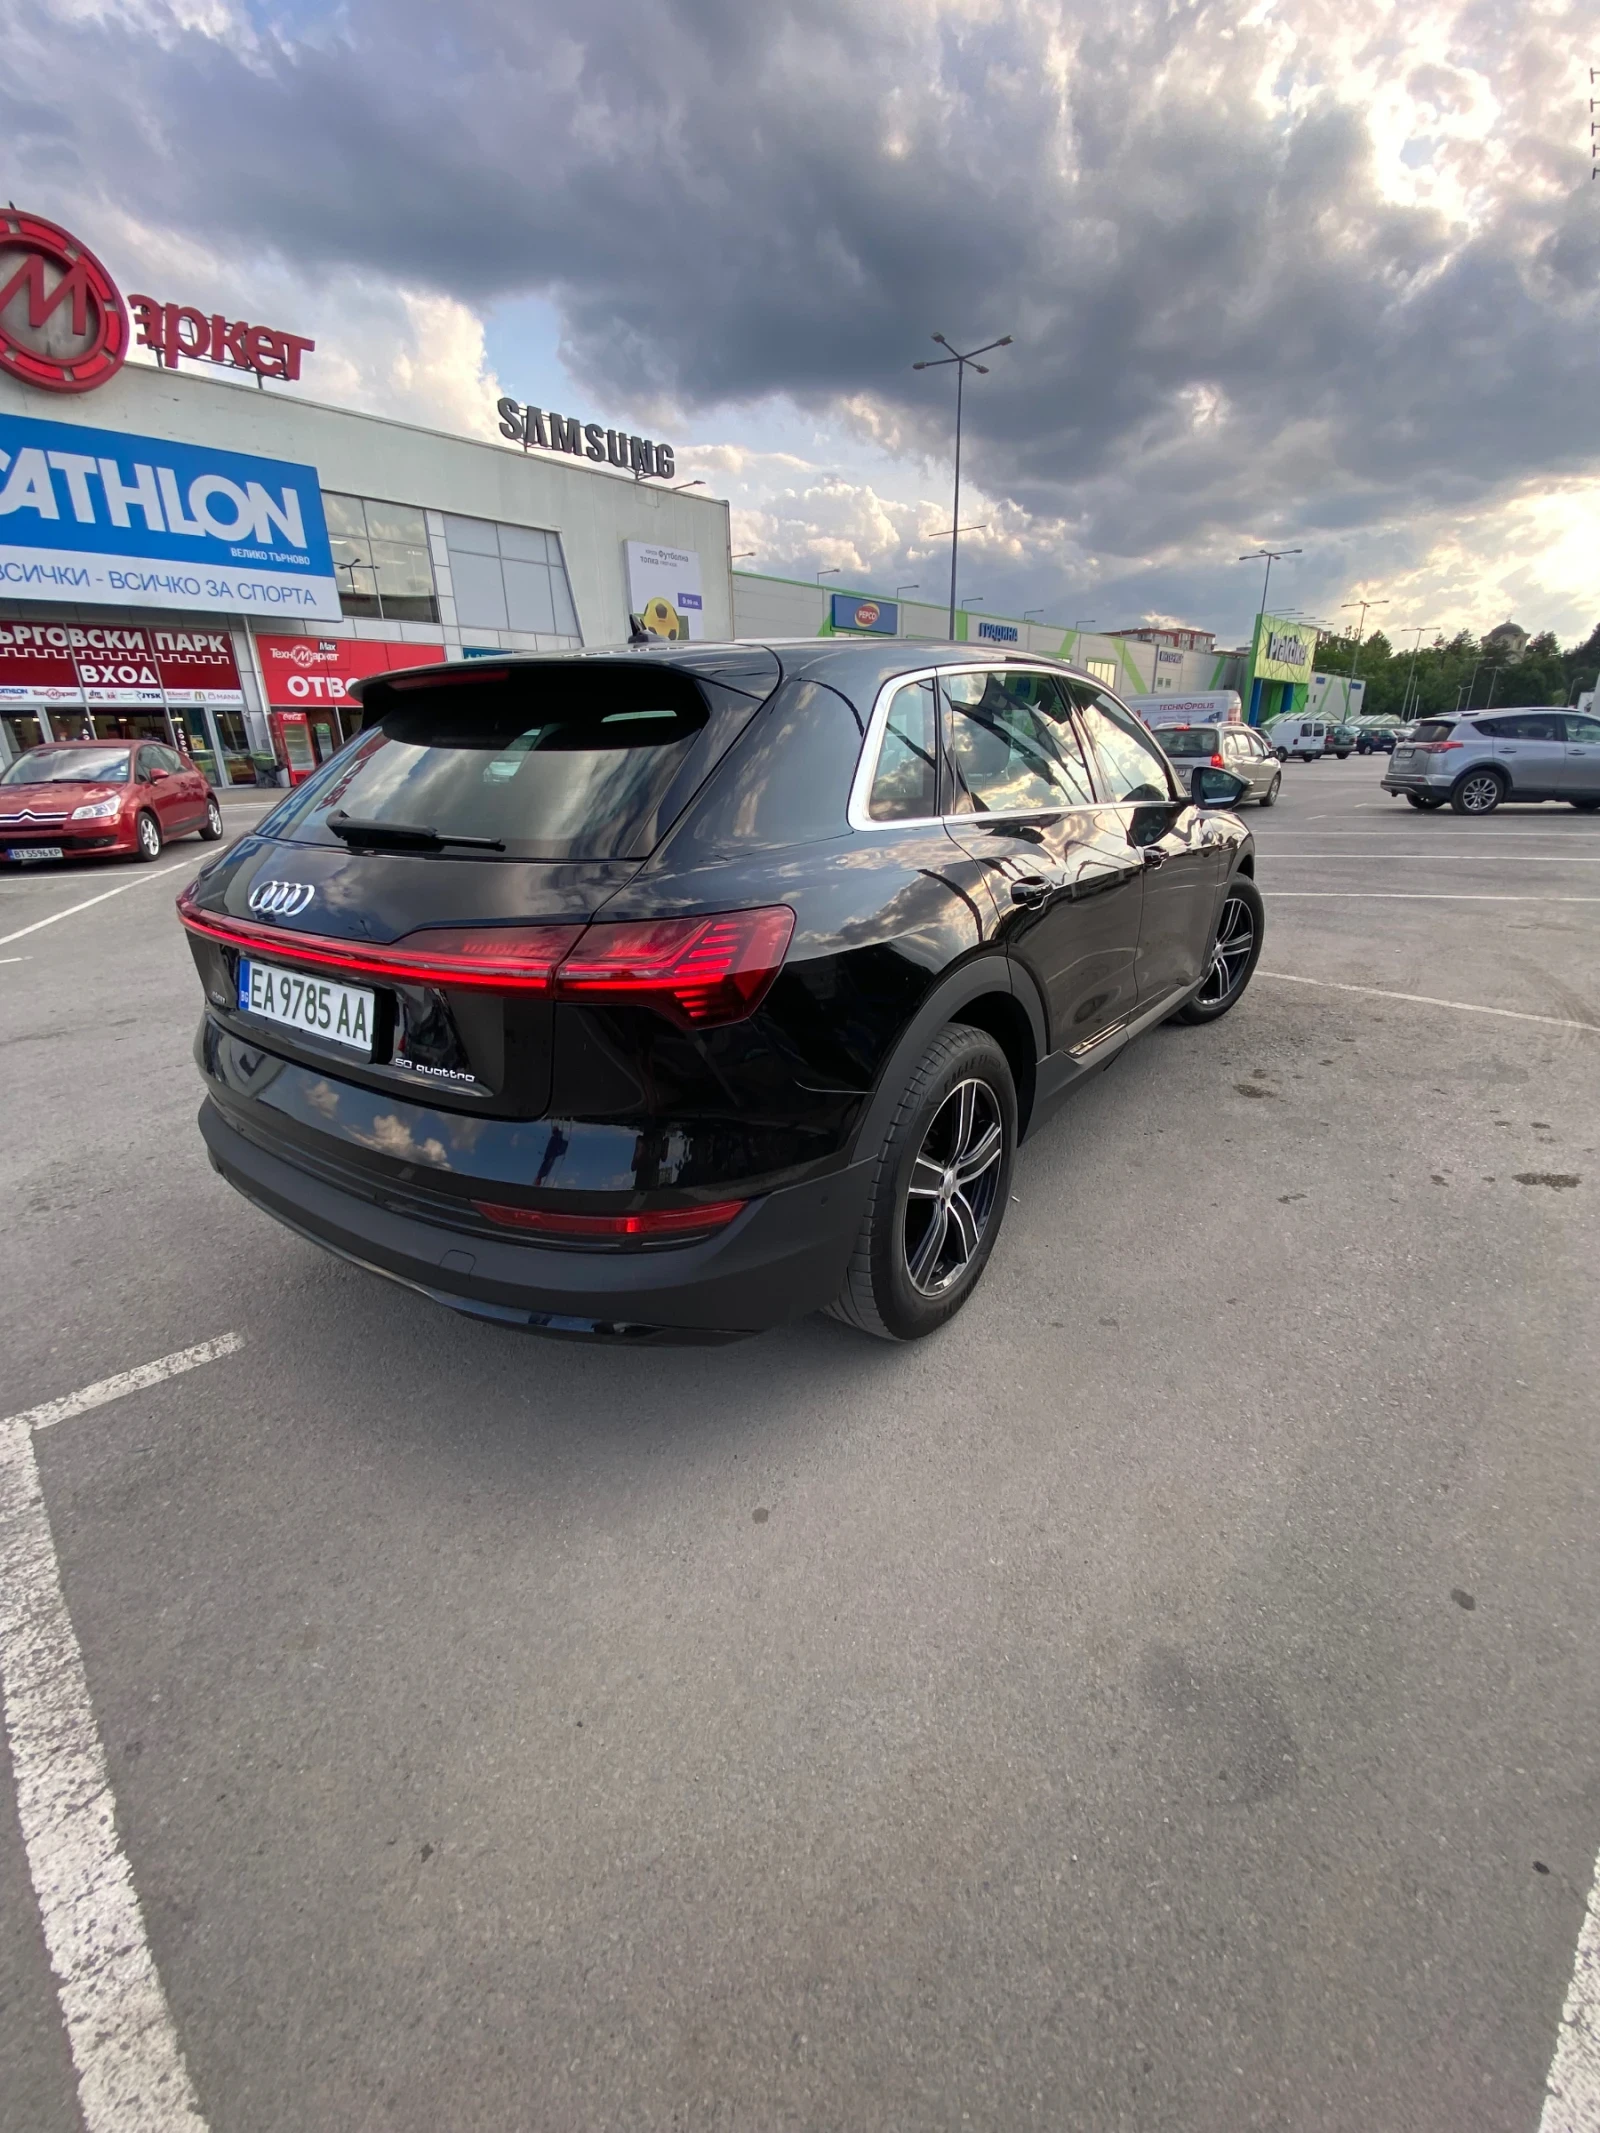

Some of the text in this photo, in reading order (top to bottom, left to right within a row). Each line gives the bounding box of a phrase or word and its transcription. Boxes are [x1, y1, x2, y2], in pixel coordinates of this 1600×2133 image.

[497, 397, 675, 479] SAMSUNG
[230, 547, 311, 566] ВЕЛИКО ТЪРНОВО
[109, 571, 200, 596] ВСИЧКО
[205, 580, 234, 600] ЗА
[237, 583, 317, 606] СПОРТА
[979, 622, 1018, 642] ГРАДИНА
[154, 632, 228, 653] ПАРК
[319, 642, 336, 651] Max
[79, 664, 158, 684] ВХОД
[1160, 702, 1215, 711] TECHNOPOLIS
[251, 968, 368, 1042] EA 9785 AA
[416, 1064, 476, 1083] quattro
